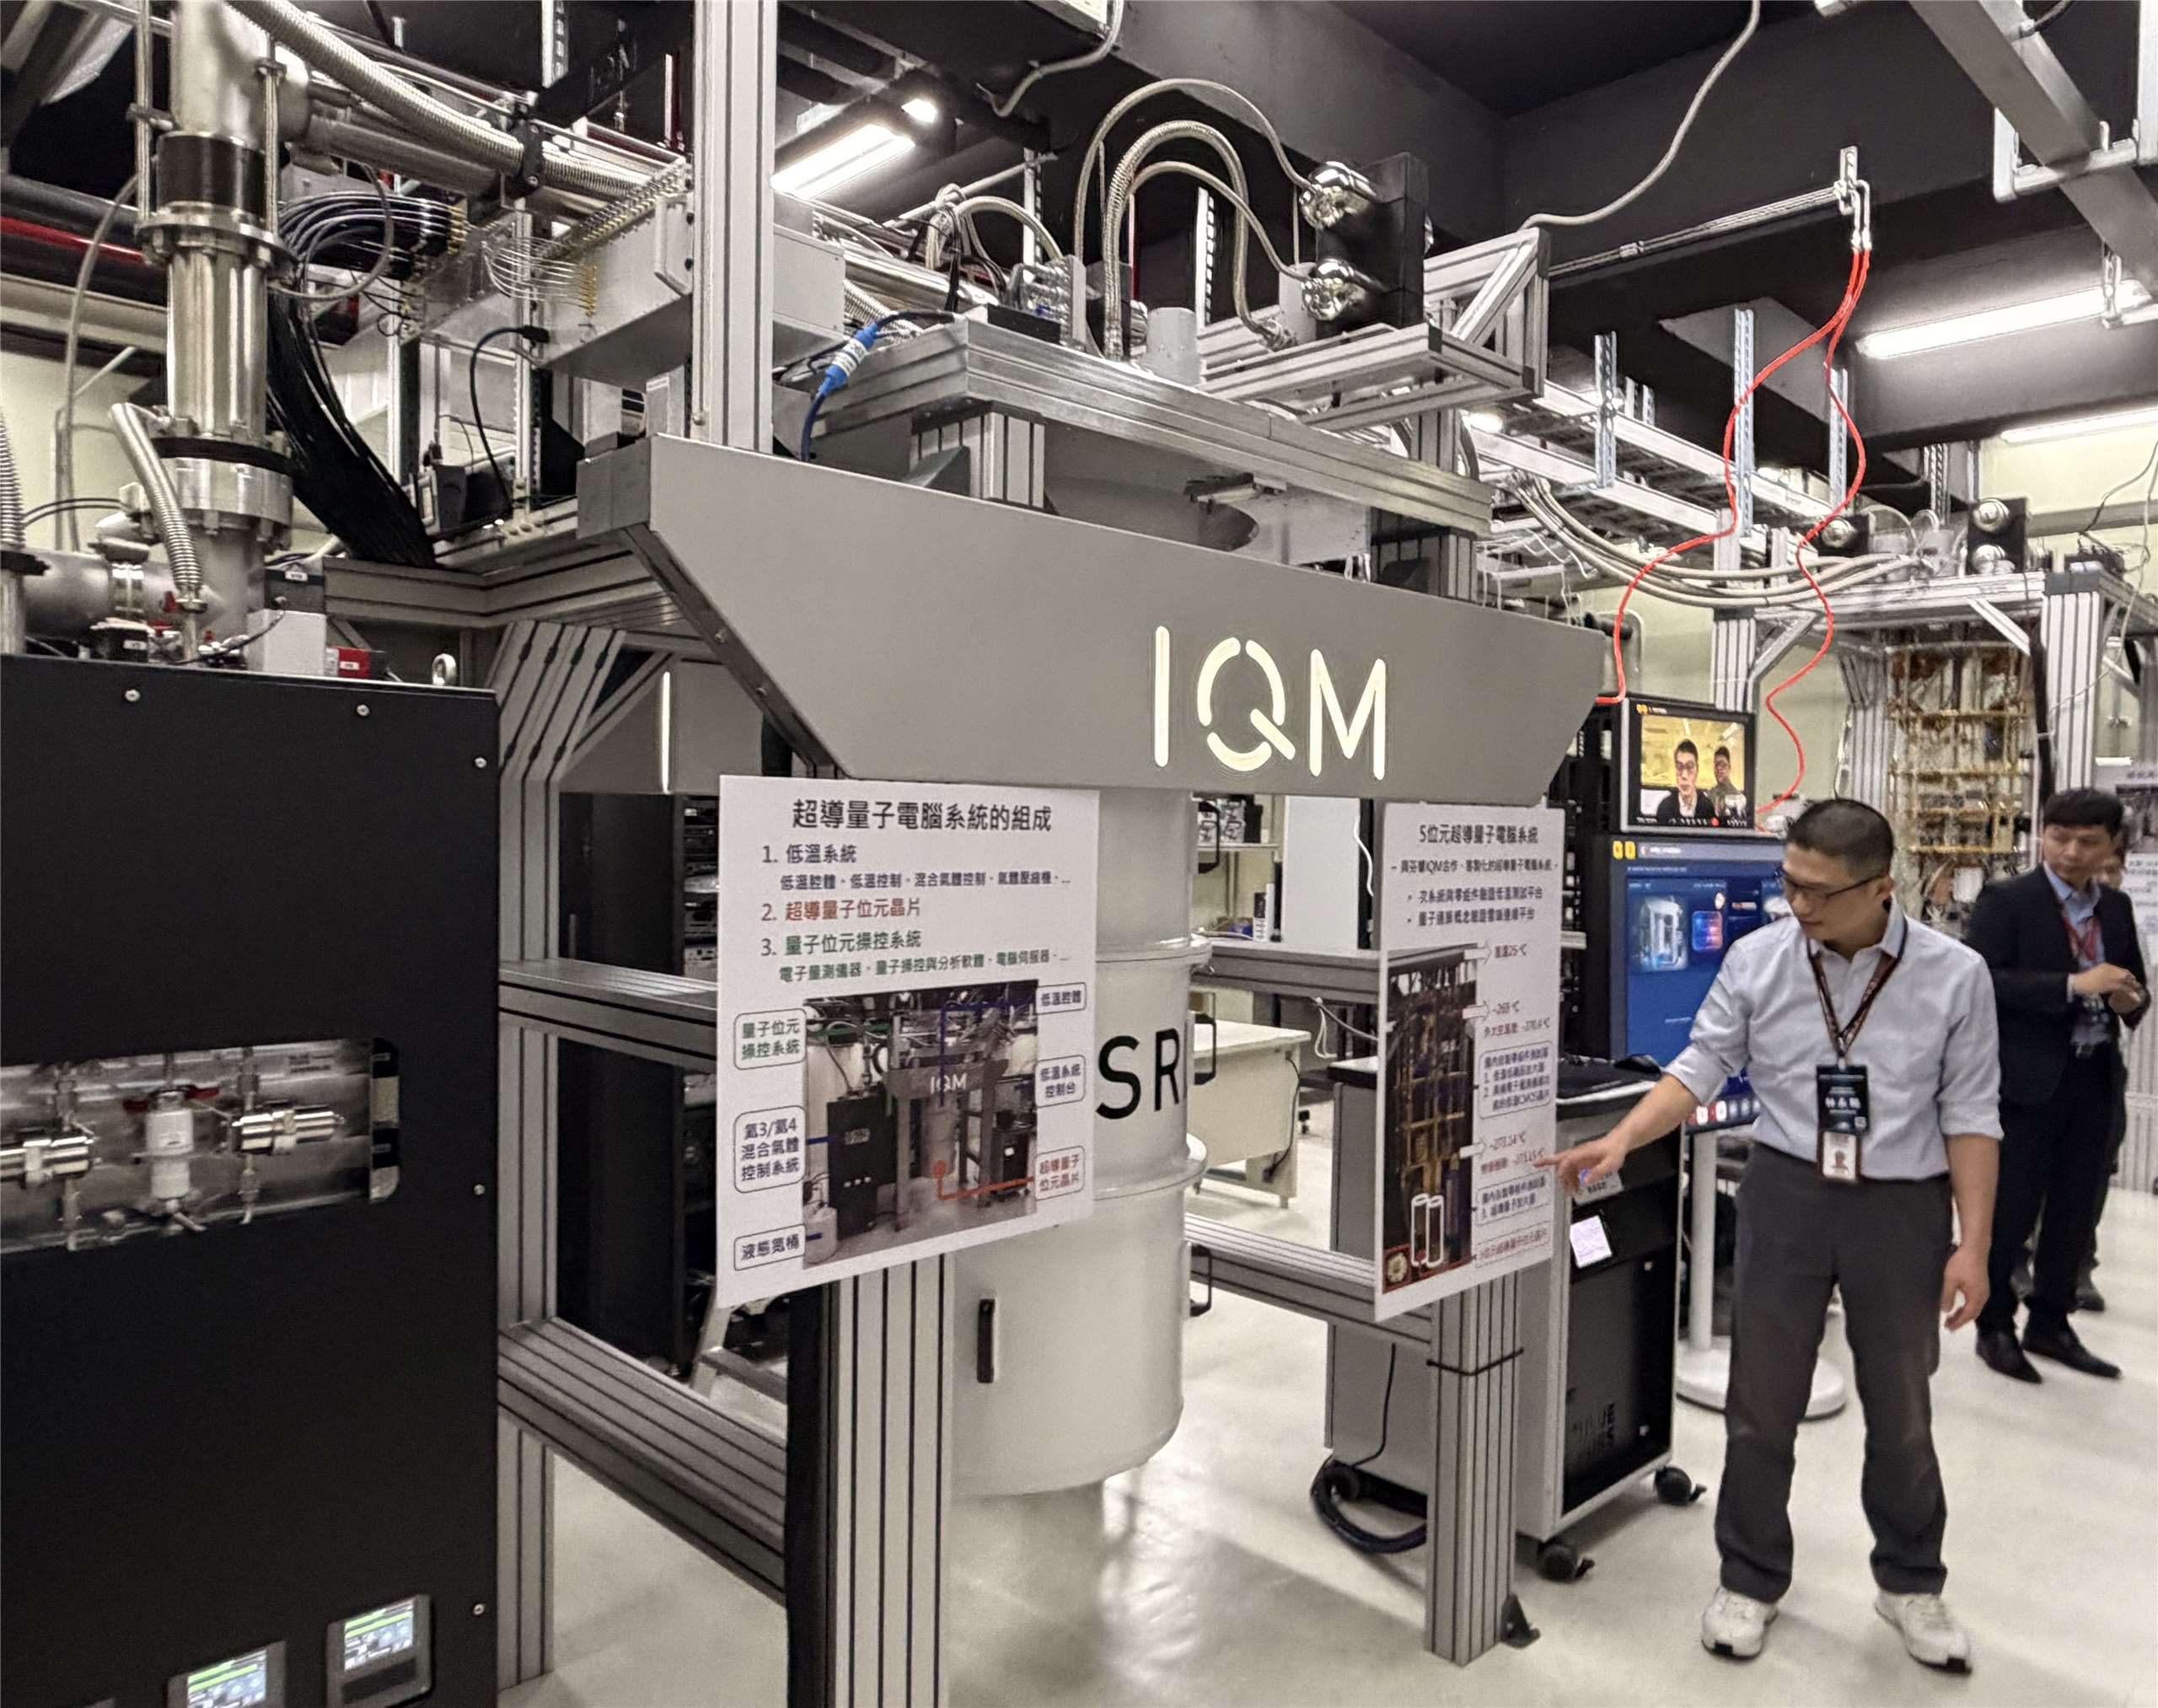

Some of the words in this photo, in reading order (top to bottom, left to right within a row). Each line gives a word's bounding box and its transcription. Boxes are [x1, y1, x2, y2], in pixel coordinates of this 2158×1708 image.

[1153, 626, 1387, 781] IQM
[792, 798, 1052, 832] 超導量子電腦系統的組成
[762, 846, 778, 863] 1.
[786, 844, 857, 864] 低溫系統
[761, 904, 777, 921] 2.
[785, 898, 921, 921] 超導量子位元晶片
[761, 939, 777, 957] 3.
[785, 930, 921, 956] 量子位元操控系統
[742, 1018, 800, 1039] 量子位元
[742, 1039, 800, 1060] 操控系統
[741, 1136, 799, 1161] 混合氣體
[742, 1157, 800, 1181] 控制系統
